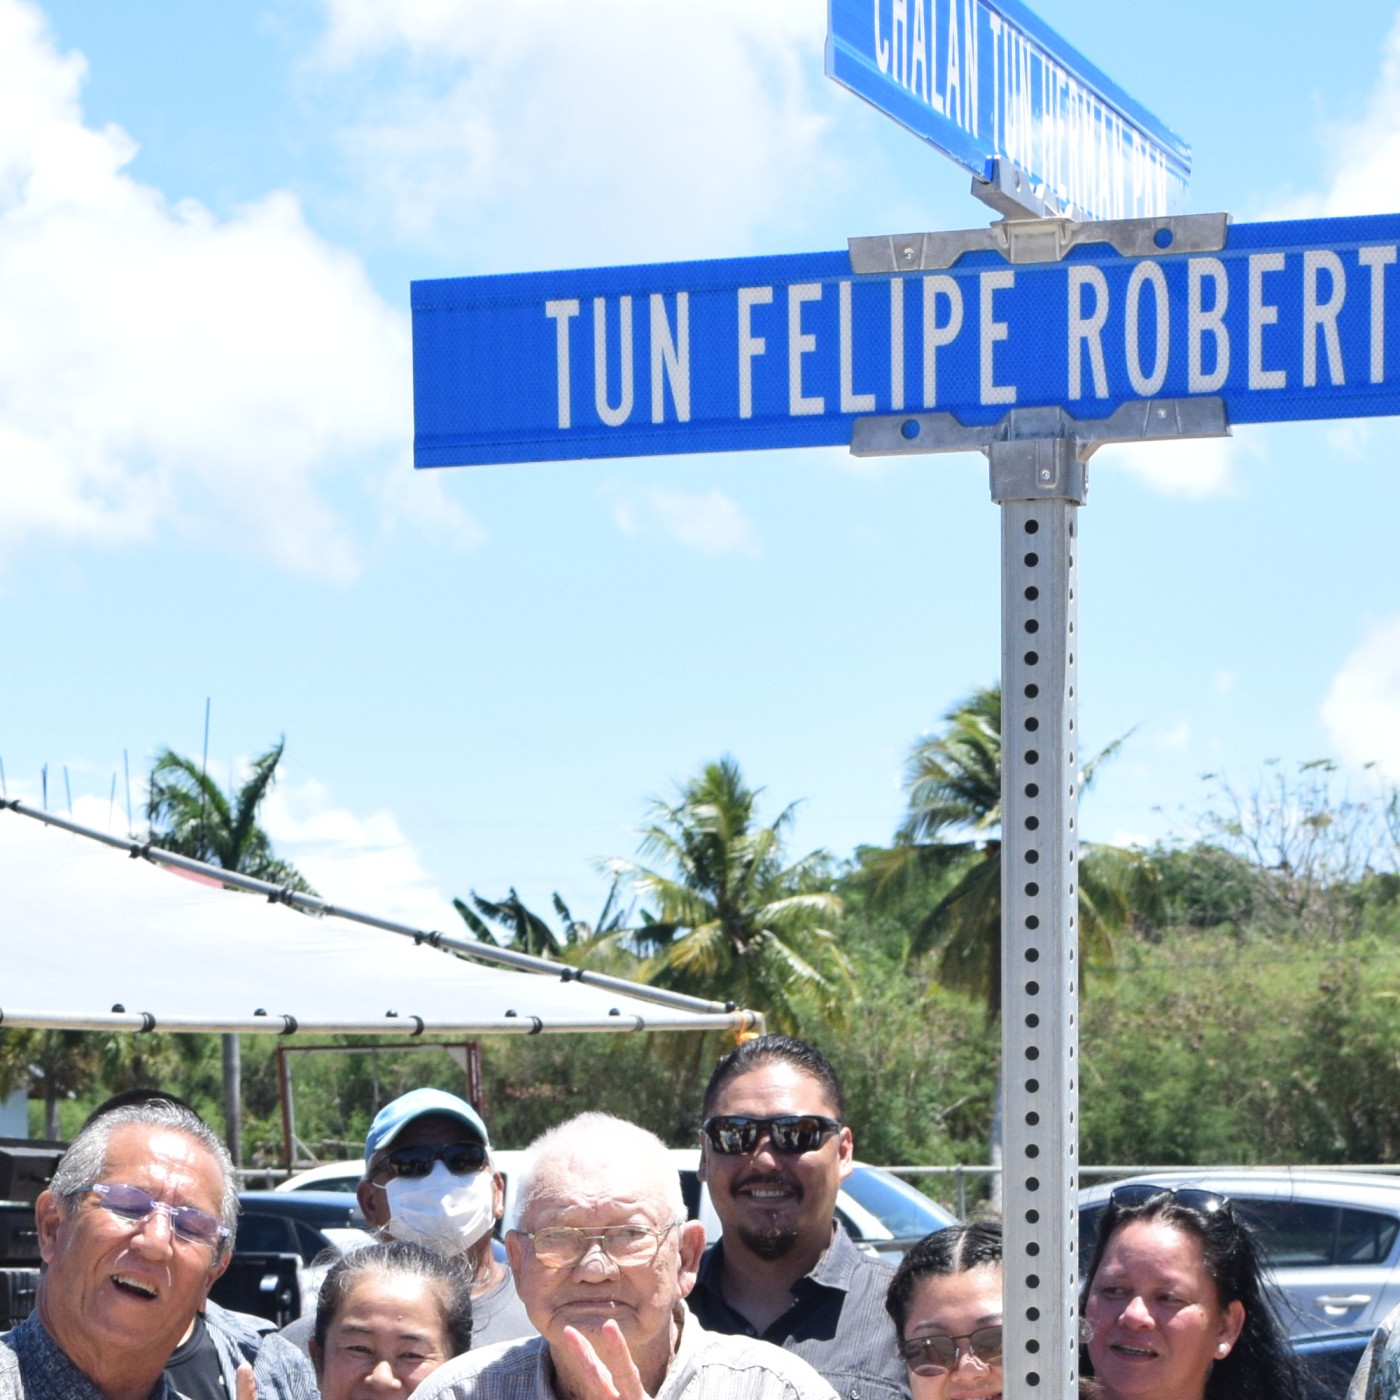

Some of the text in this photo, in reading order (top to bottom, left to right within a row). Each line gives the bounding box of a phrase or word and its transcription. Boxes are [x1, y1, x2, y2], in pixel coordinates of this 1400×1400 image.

[990, 11, 1033, 177] TUN
[546, 292, 690, 431] TUN
[738, 271, 1016, 418] FELIPE
